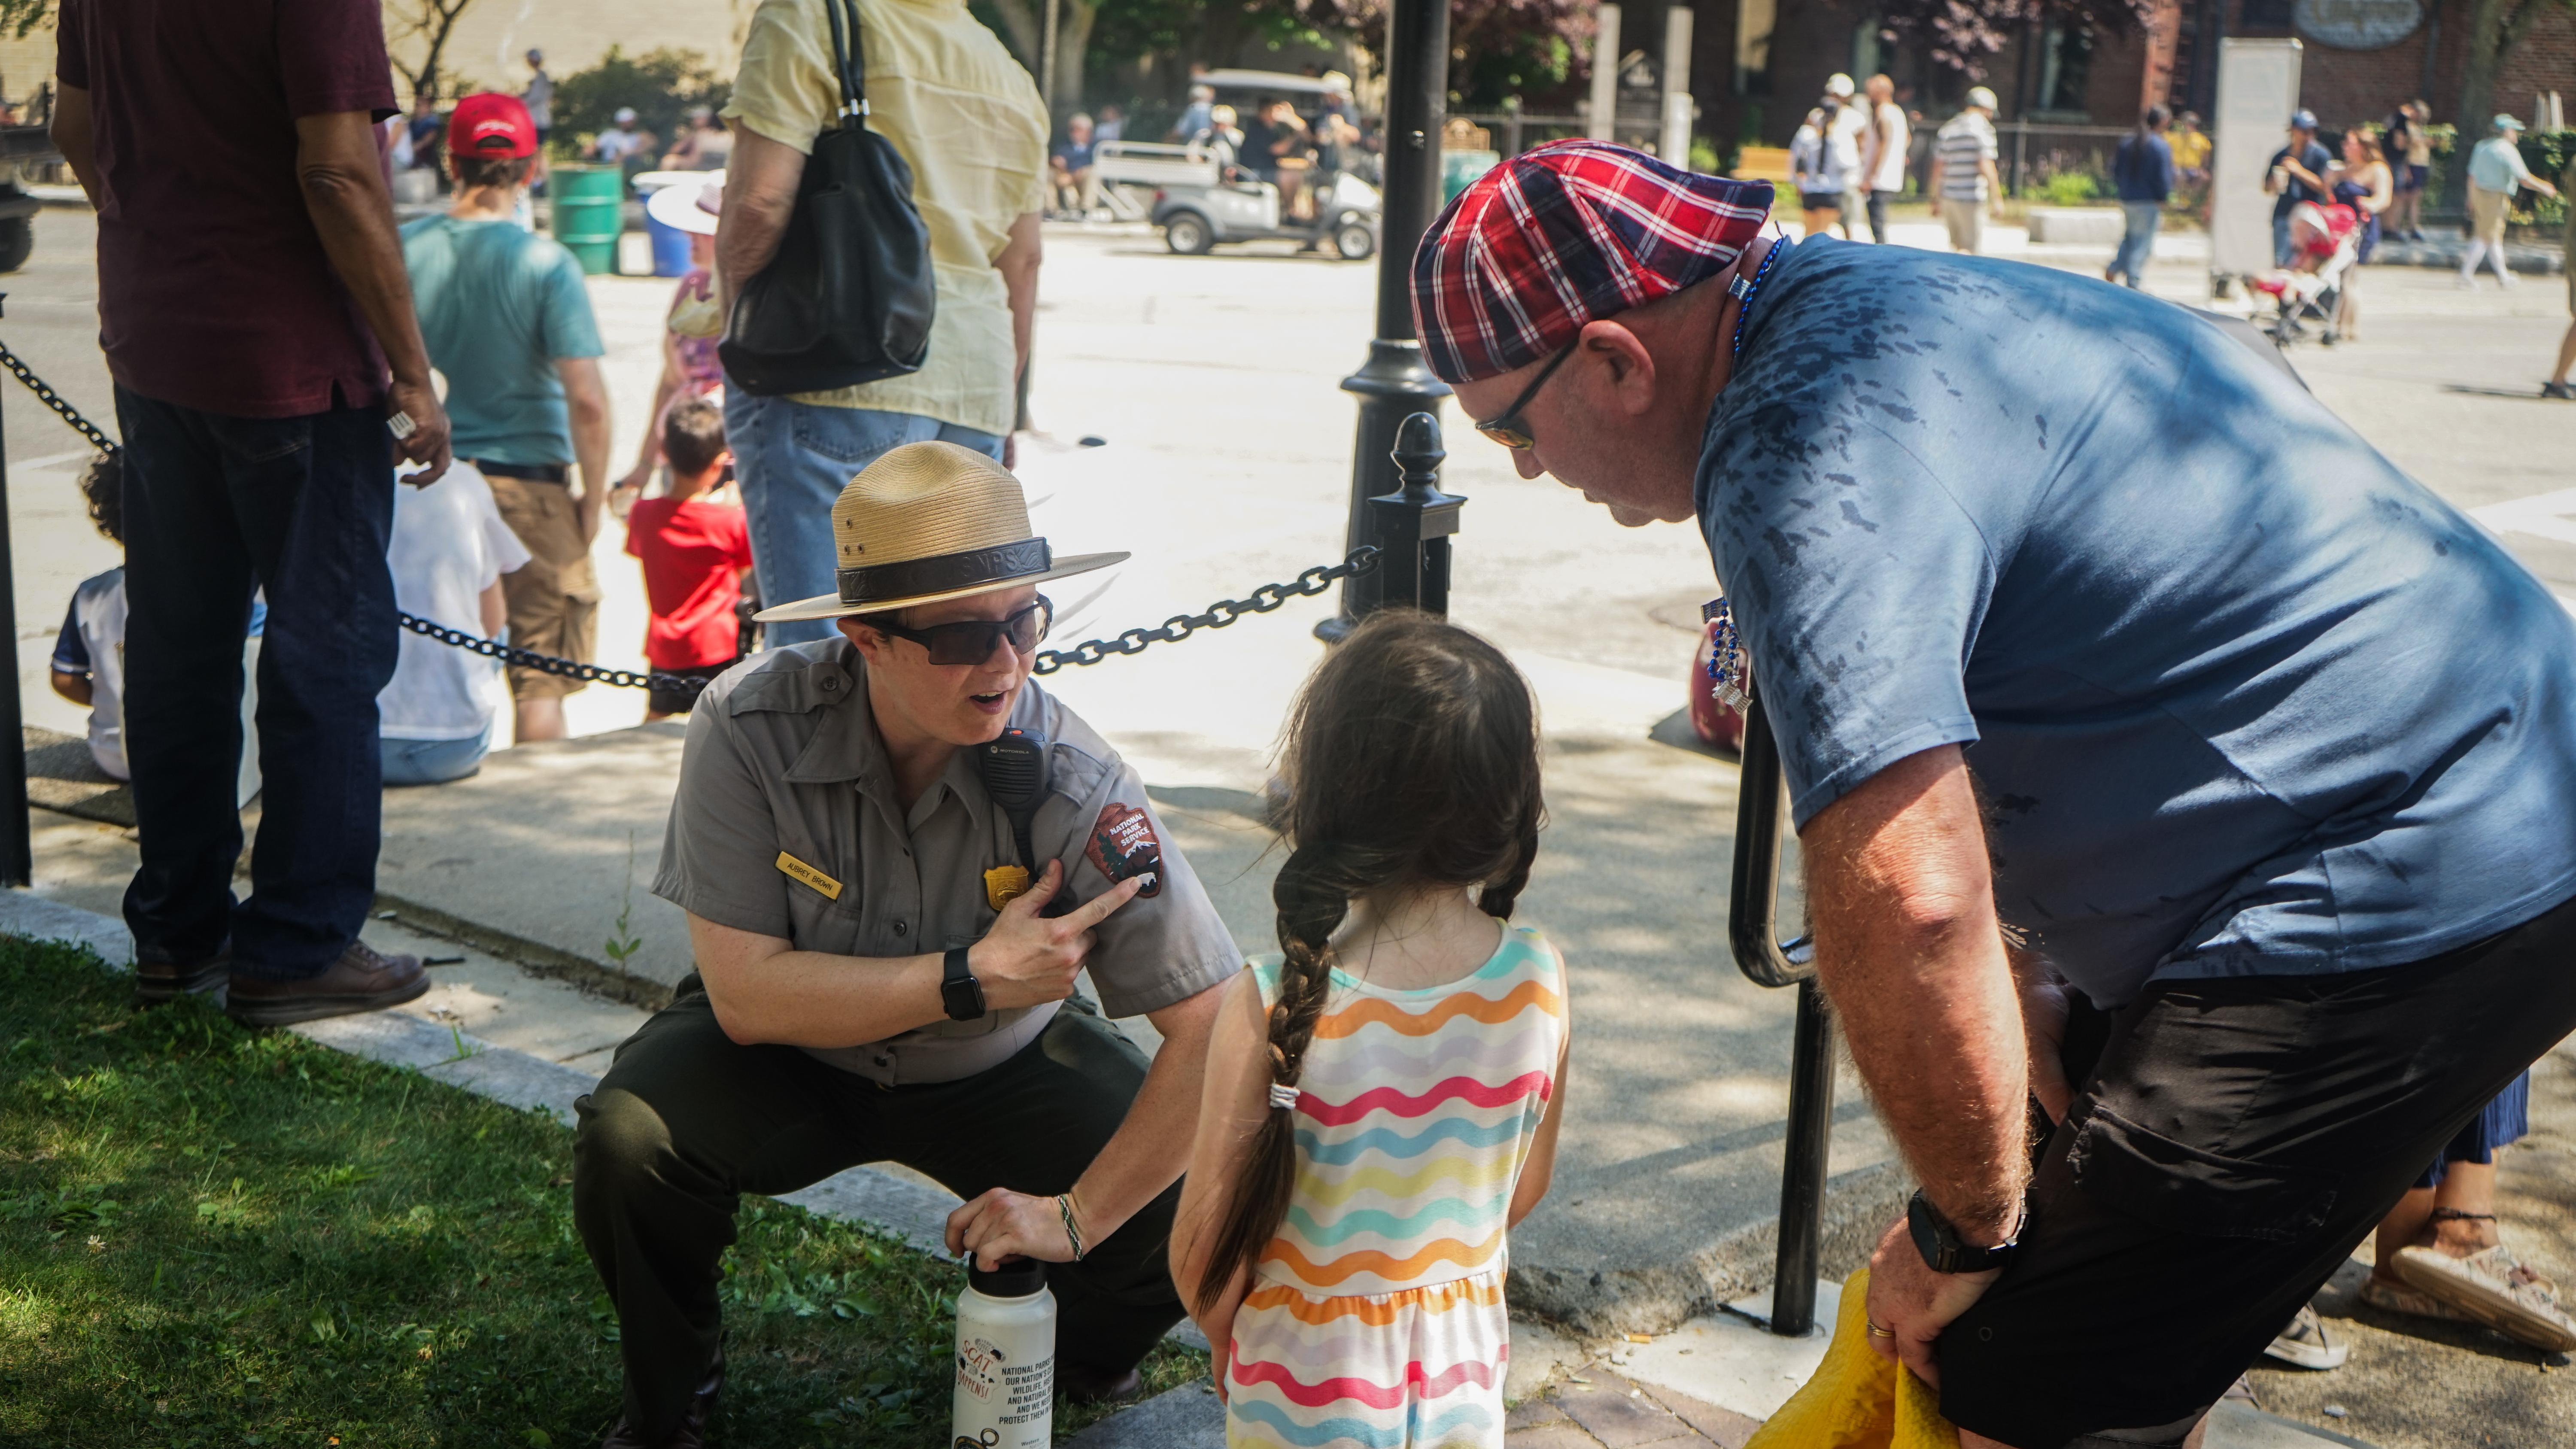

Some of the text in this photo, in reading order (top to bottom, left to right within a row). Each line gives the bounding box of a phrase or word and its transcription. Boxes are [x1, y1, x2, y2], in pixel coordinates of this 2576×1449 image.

[1109, 813, 1144, 835] NATIONAL
[1122, 823, 1141, 837] PARK
[1121, 826, 1150, 847] SERVICE
[787, 863, 833, 891] AUBREY BROWN
[963, 1340, 993, 1372] SCAT
[1002, 1365, 1034, 1376] NATIONAL
[1035, 1358, 1050, 1371] PARKS
[958, 1369, 989, 1399] HAPPENS!
[1006, 1369, 1047, 1385] OUR NATION'S
[1013, 1381, 1042, 1394] WILDLIFE,
[1008, 1389, 1047, 1405] AND NATURAL
[1017, 1405, 1030, 1414] AND
[1032, 1401, 1040, 1411] WE
[999, 1414, 1029, 1425] PROTECT
[1030, 1408, 1044, 1421] THEM
[1021, 1438, 1039, 1446] Western
